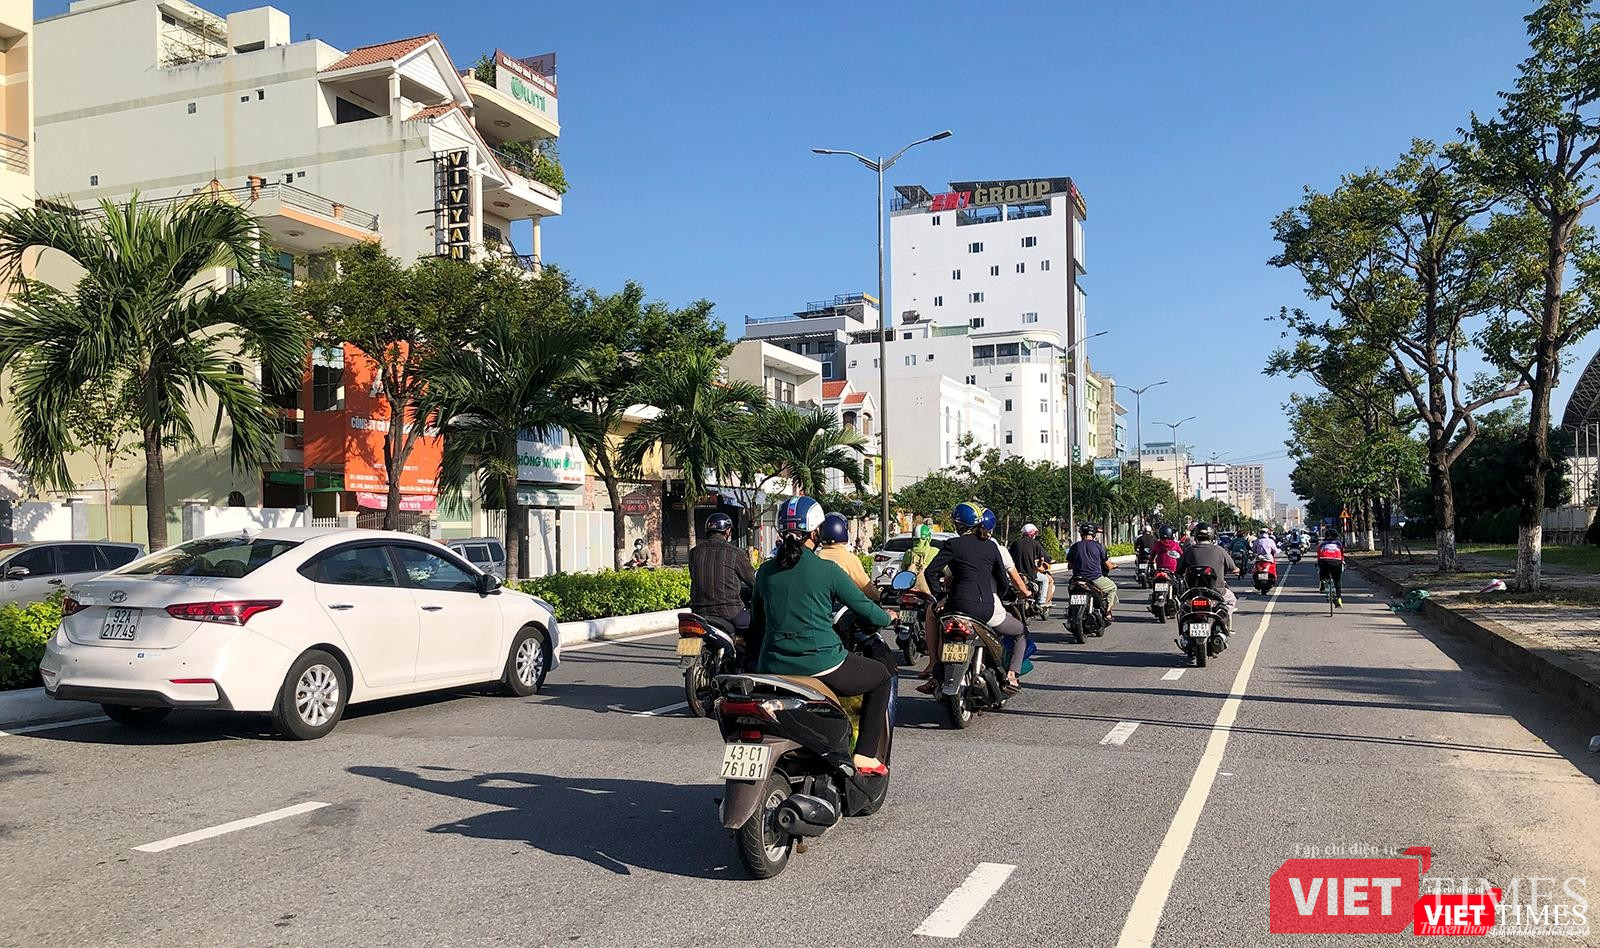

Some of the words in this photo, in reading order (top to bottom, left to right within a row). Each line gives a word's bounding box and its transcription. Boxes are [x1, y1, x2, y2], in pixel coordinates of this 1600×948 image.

[974, 181, 1050, 206] GROUP
[516, 452, 542, 467] HÔNG
[113, 609, 131, 623] 92A
[103, 623, 136, 638] 217.49
[730, 746, 762, 761] 43-C1
[722, 761, 763, 778] 761.81
